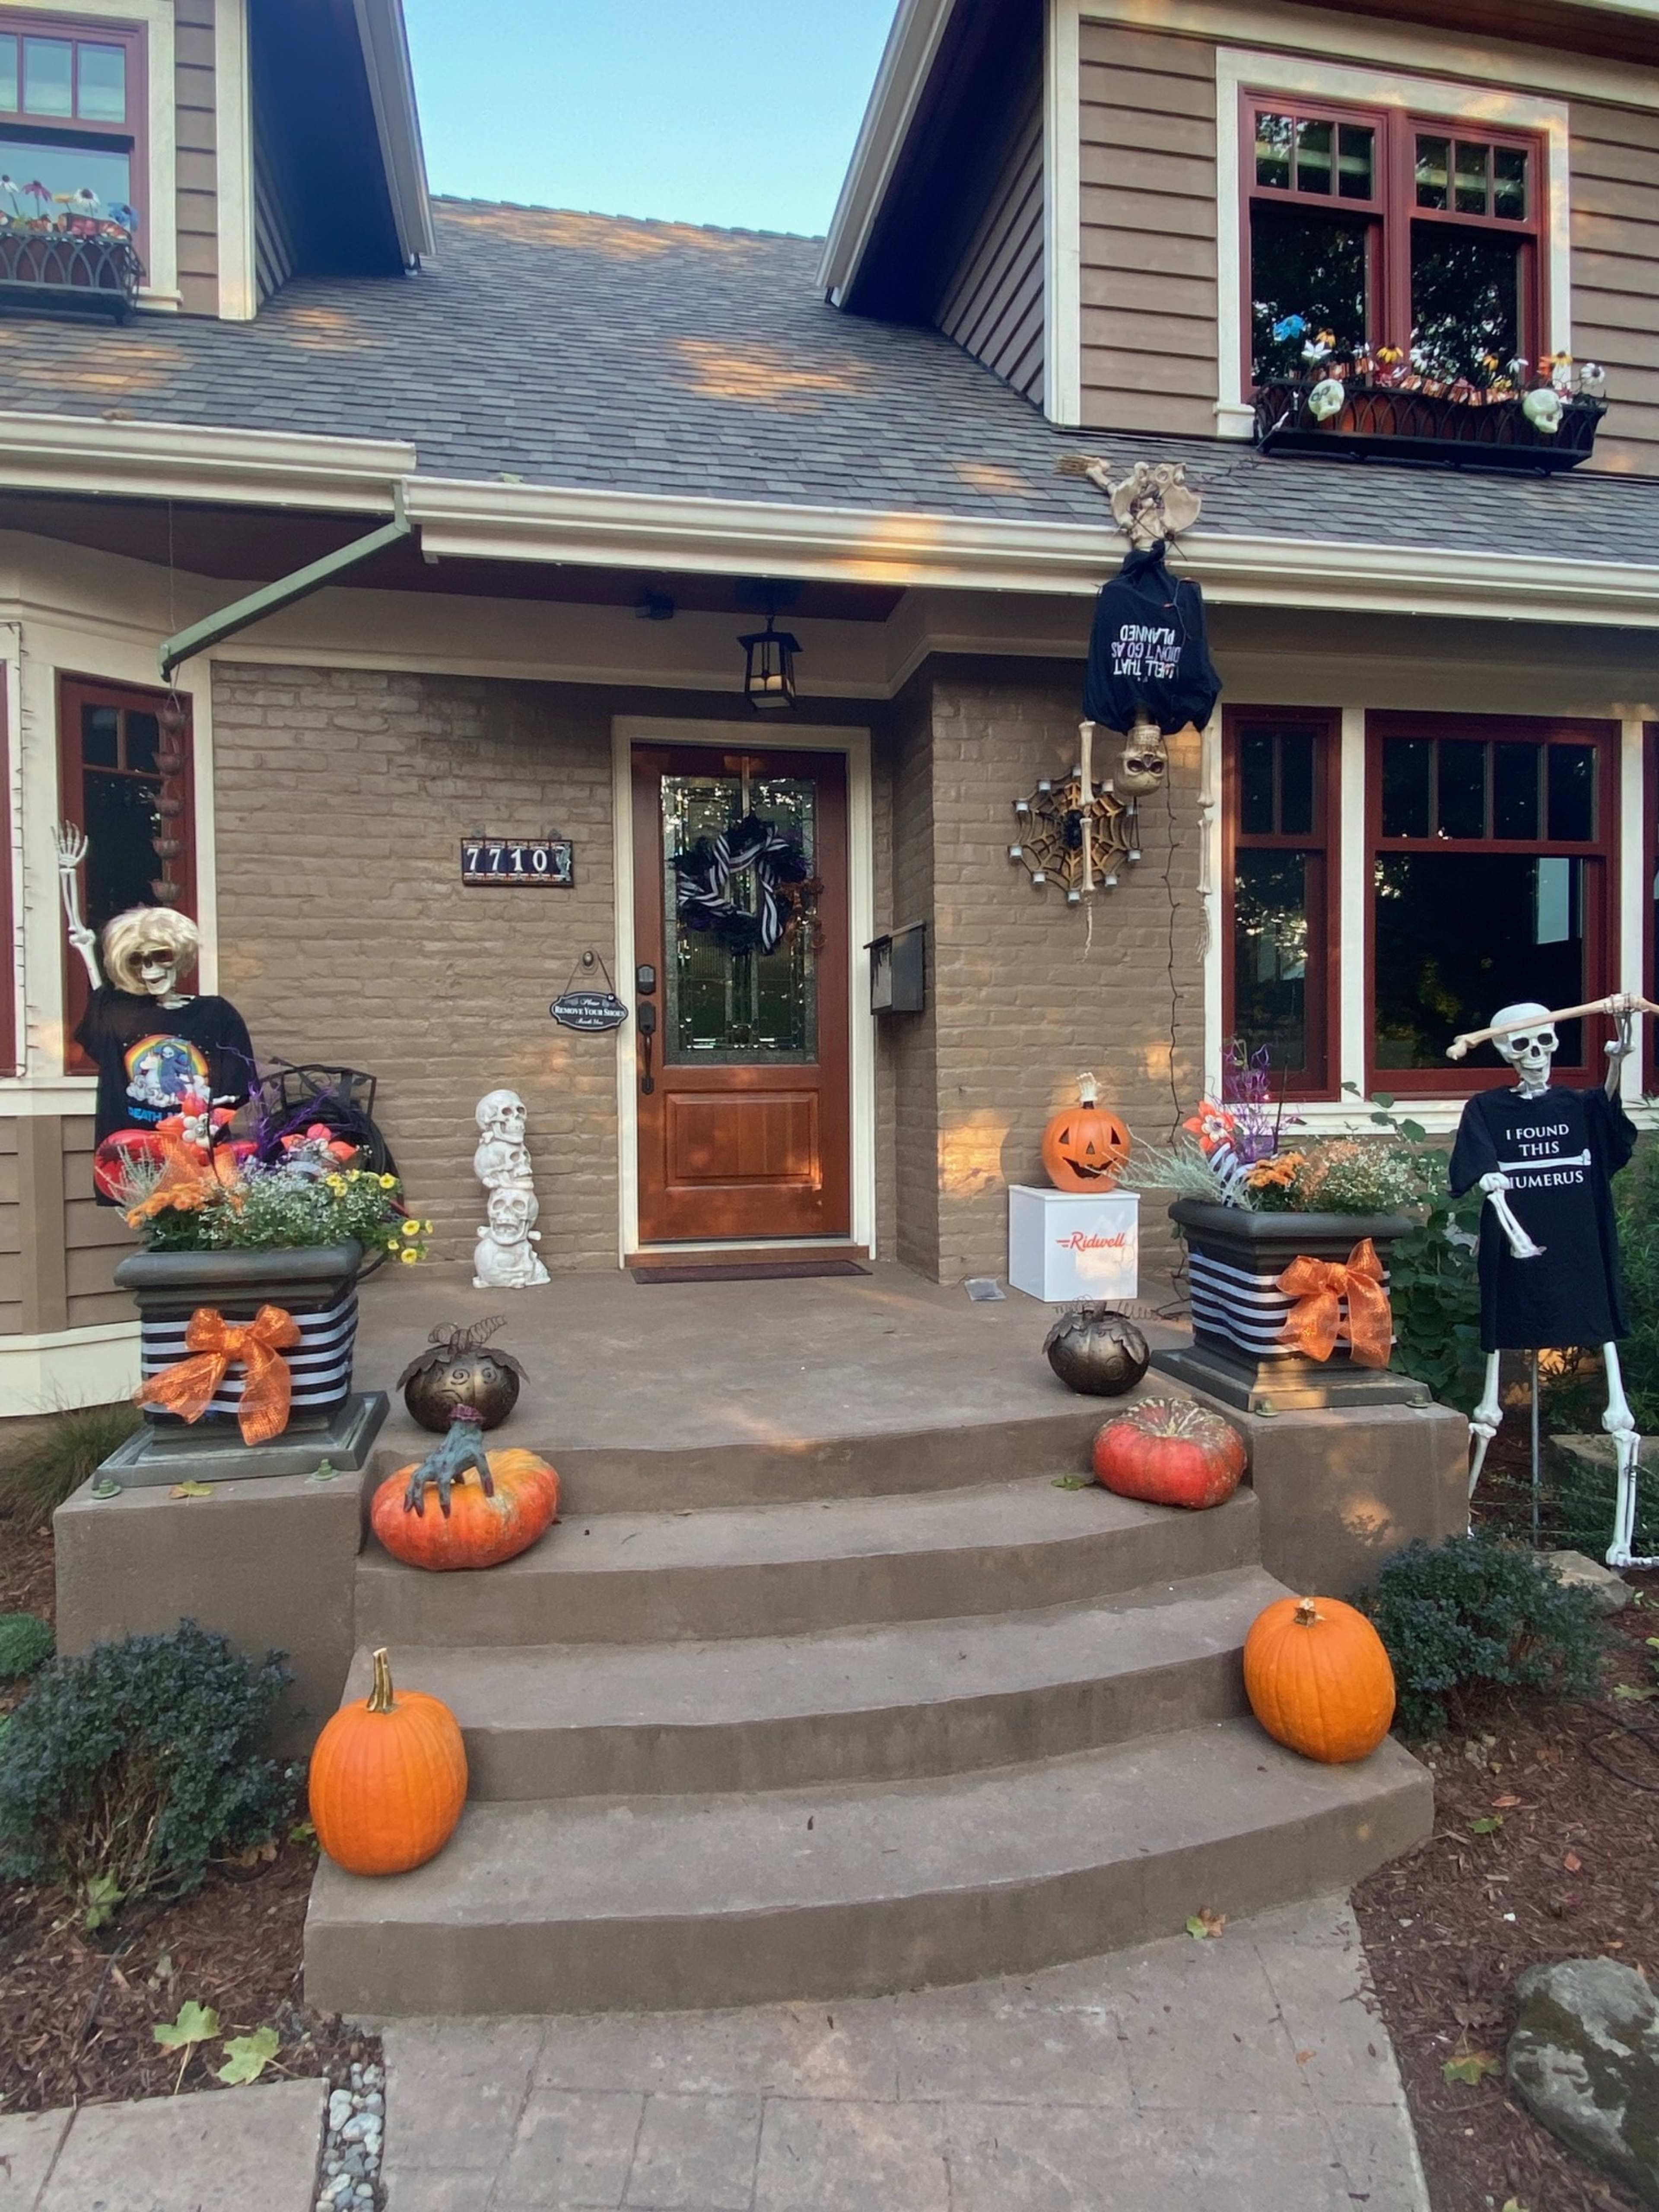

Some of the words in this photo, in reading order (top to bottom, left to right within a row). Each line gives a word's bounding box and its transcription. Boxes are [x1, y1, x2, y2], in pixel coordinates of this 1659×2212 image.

[1120, 625, 1175, 645] PLANNED
[1111, 642, 1125, 658] AS
[1127, 642, 1143, 658] GO
[1113, 658, 1141, 675] THAT
[1145, 660, 1176, 679] WELL
[584, 1007, 602, 1016] YOUR
[128, 1106, 163, 1122] DEATH
[1506, 1129, 1511, 1141] I
[1516, 1124, 1570, 1140] FOUND
[1518, 1141, 1560, 1157] THIS
[1070, 1231, 1125, 1252] Ridwell
